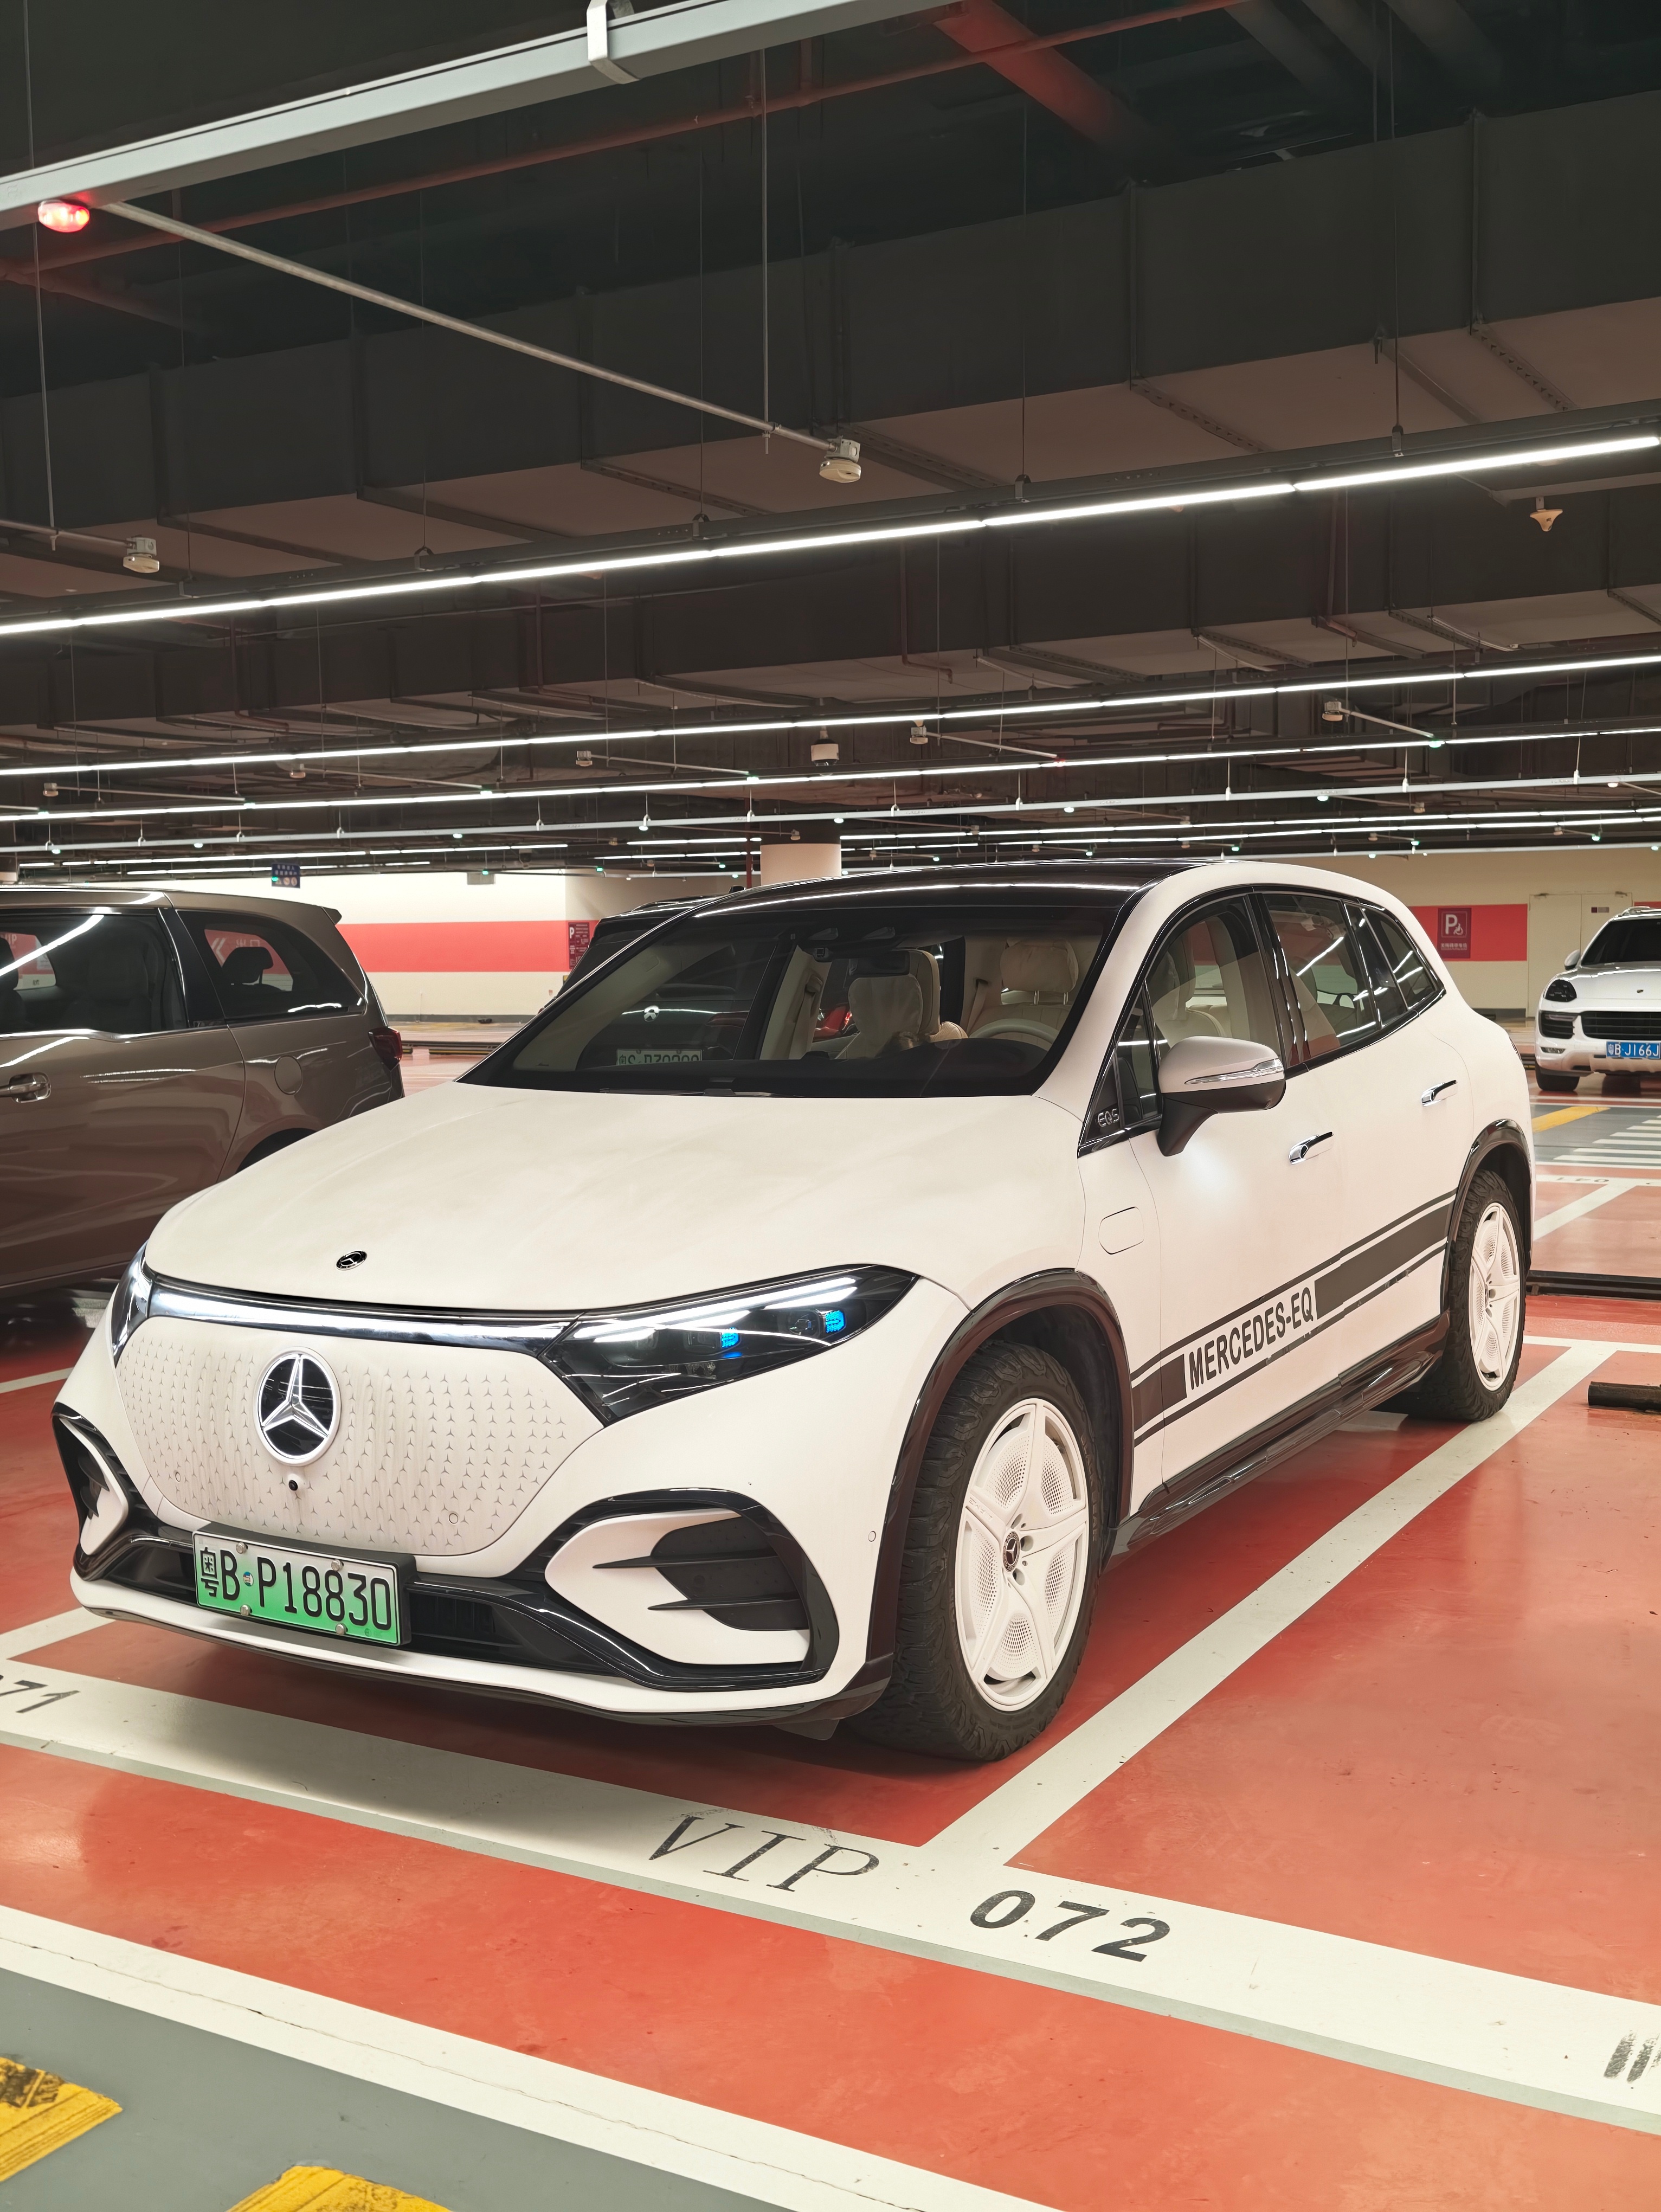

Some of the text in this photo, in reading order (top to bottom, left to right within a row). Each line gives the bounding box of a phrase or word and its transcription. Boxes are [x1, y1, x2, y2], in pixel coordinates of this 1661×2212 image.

[569, 927, 575, 939] P
[1445, 914, 1458, 935] P
[1097, 1108, 1119, 1127] EQS
[1188, 1287, 1314, 1391] MERCEDES-EQ
[0, 1674, 81, 1714] 71
[648, 1813, 880, 1892] VIP
[970, 1890, 1170, 1963] 072
